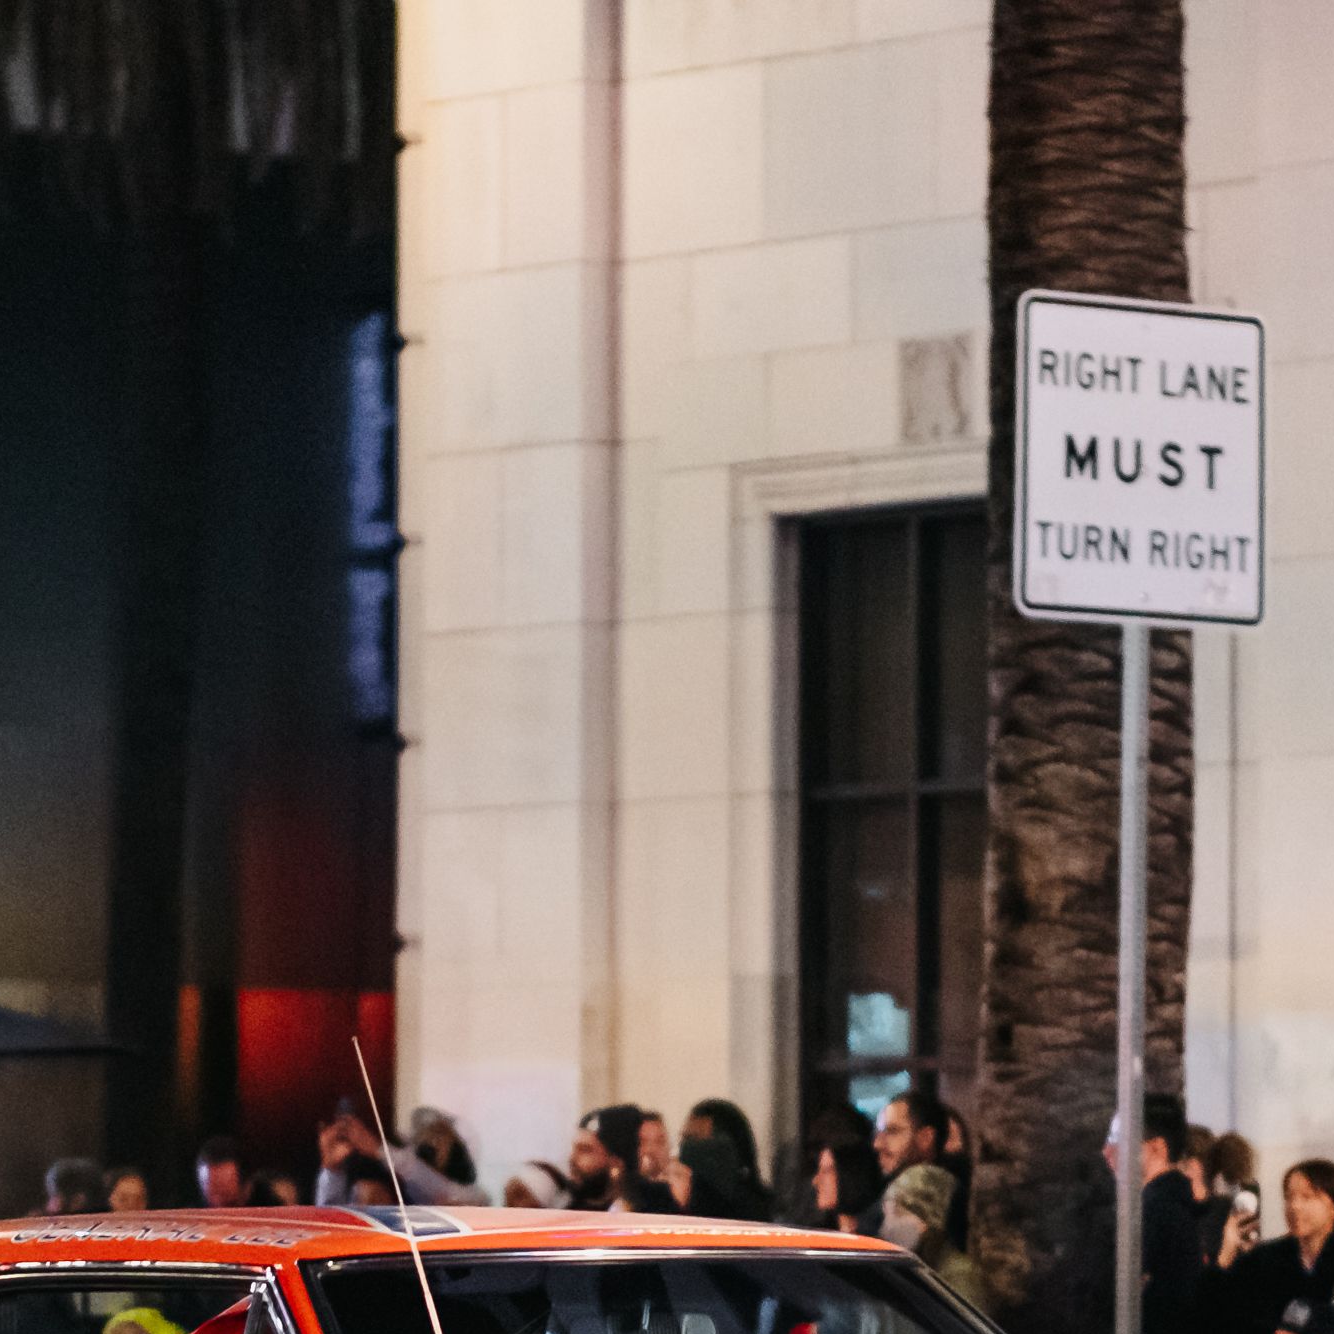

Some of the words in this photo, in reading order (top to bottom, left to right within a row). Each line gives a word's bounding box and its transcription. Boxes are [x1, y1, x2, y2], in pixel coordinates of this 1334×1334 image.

[1038, 349, 1144, 394] RIGHT
[1160, 361, 1251, 405] LANE
[1064, 433, 1224, 491] MUST
[1035, 520, 1132, 563] TURN
[1149, 530, 1251, 574] RIGHT
